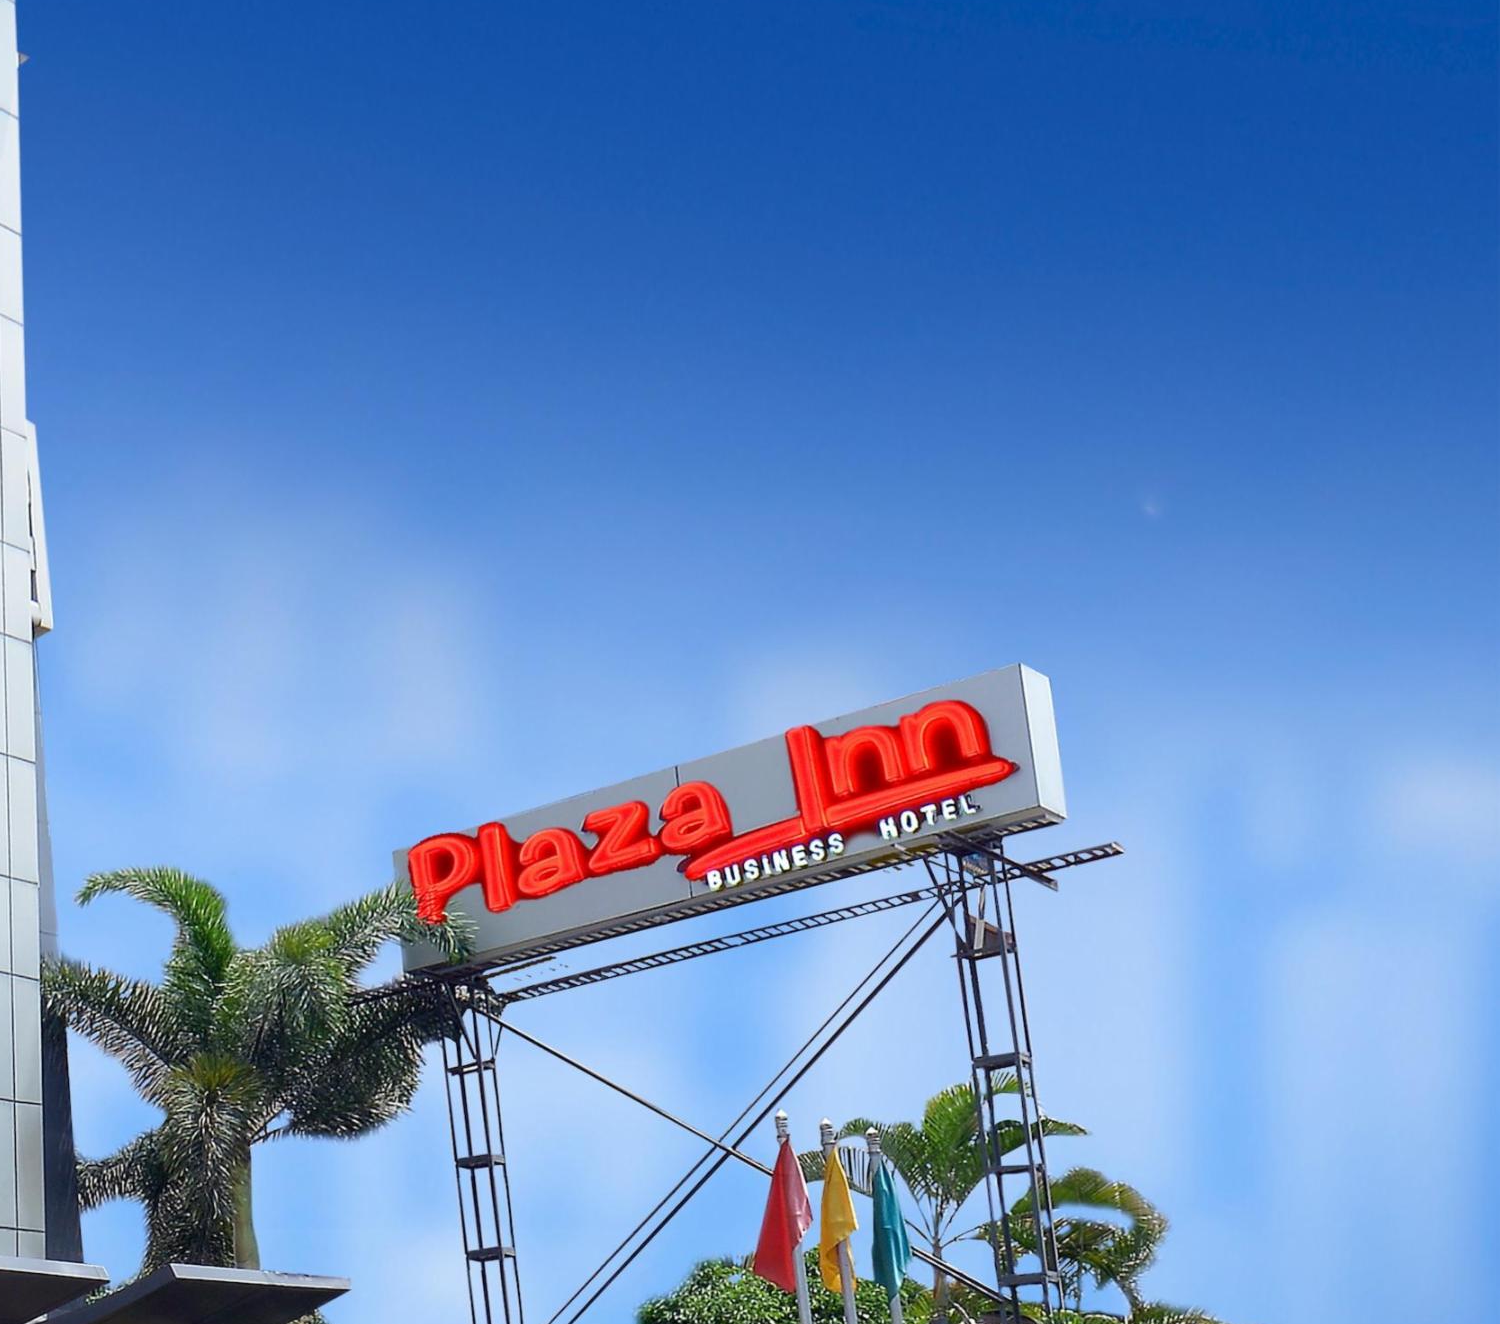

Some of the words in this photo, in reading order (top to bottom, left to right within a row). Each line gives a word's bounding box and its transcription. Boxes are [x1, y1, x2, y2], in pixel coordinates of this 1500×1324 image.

[407, 779, 733, 924] Plaza
[785, 699, 1018, 838] Inn
[878, 793, 978, 840] HOTEL
